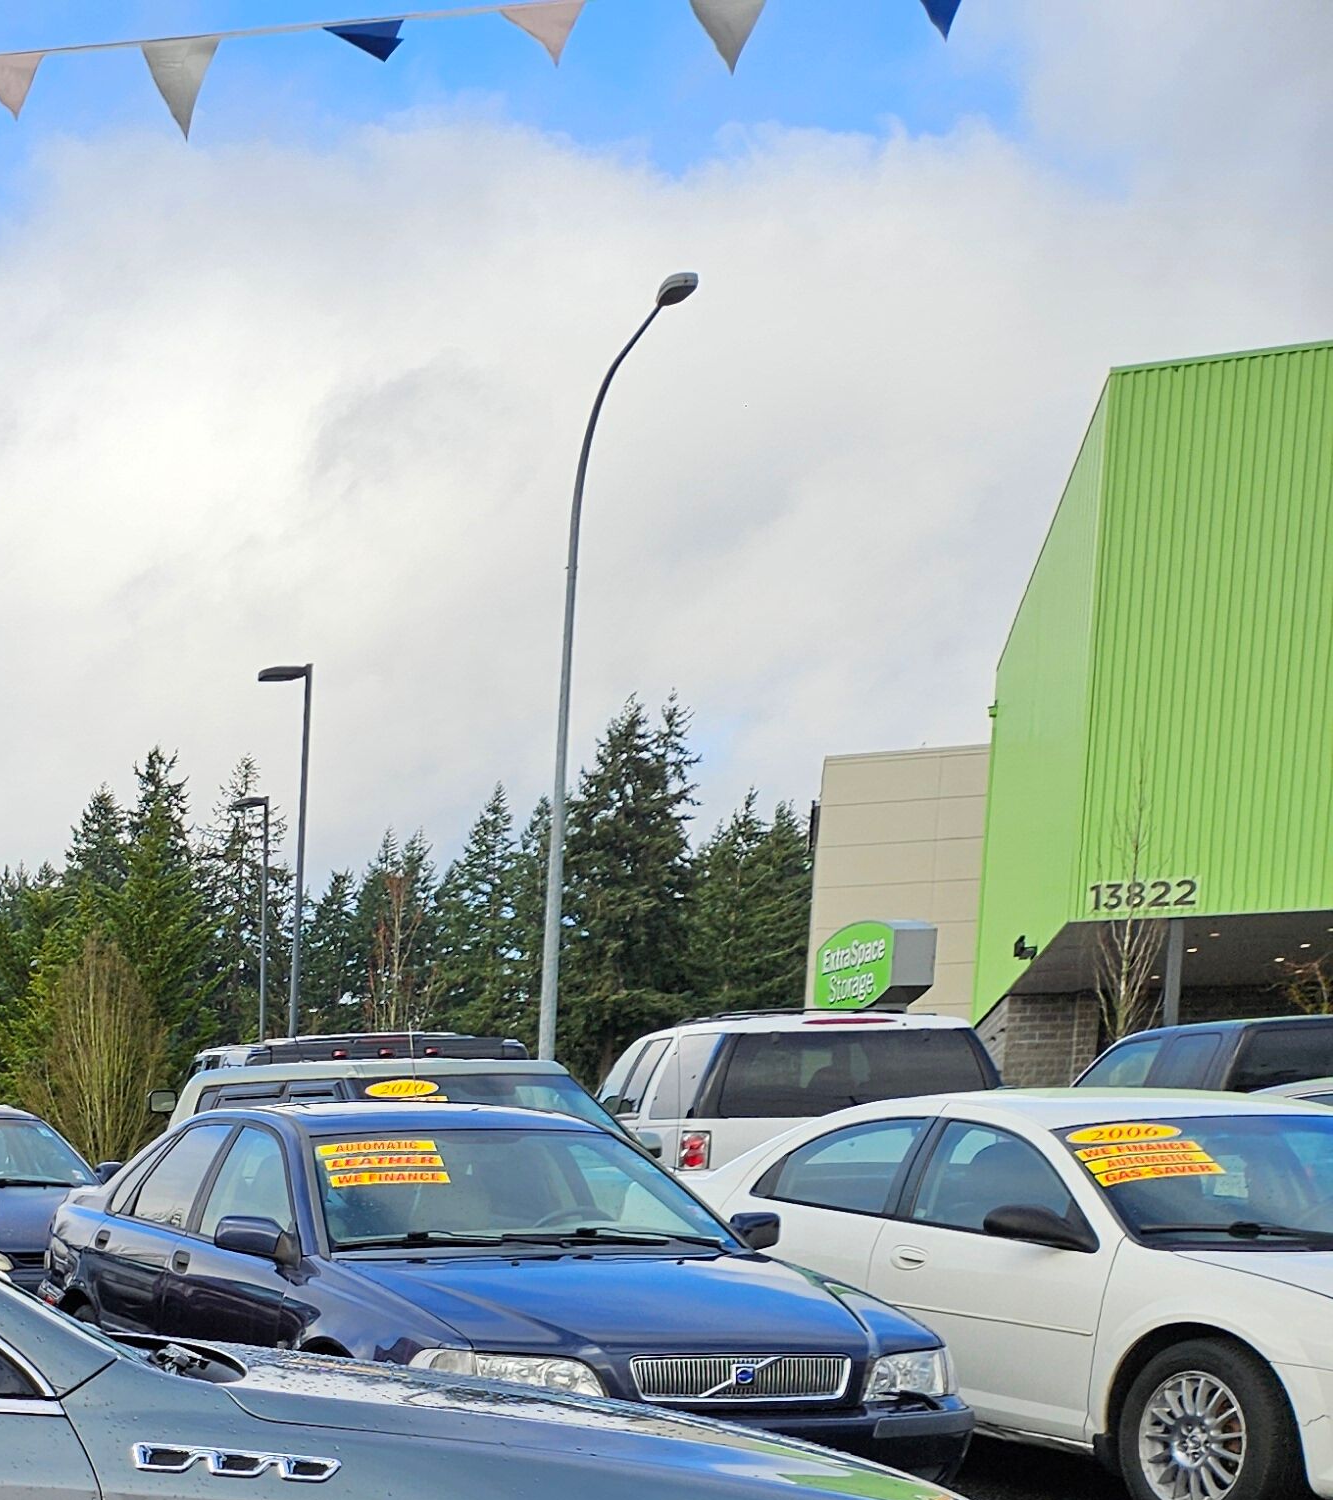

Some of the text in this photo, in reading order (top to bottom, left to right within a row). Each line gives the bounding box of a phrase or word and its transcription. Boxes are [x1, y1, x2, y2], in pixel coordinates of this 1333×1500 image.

[1090, 879, 1197, 911] 13822
[827, 972, 875, 1004] Storage
[380, 1082, 425, 1095] 2010
[1090, 1126, 1159, 1142] 2006
[335, 1141, 420, 1152] AUTOMATIC
[1083, 1141, 1192, 1159] WE FINANCE
[331, 1156, 437, 1168] LEATHER
[1106, 1152, 1194, 1169] AUTOMATIC
[337, 1172, 441, 1184] WE FINANCE
